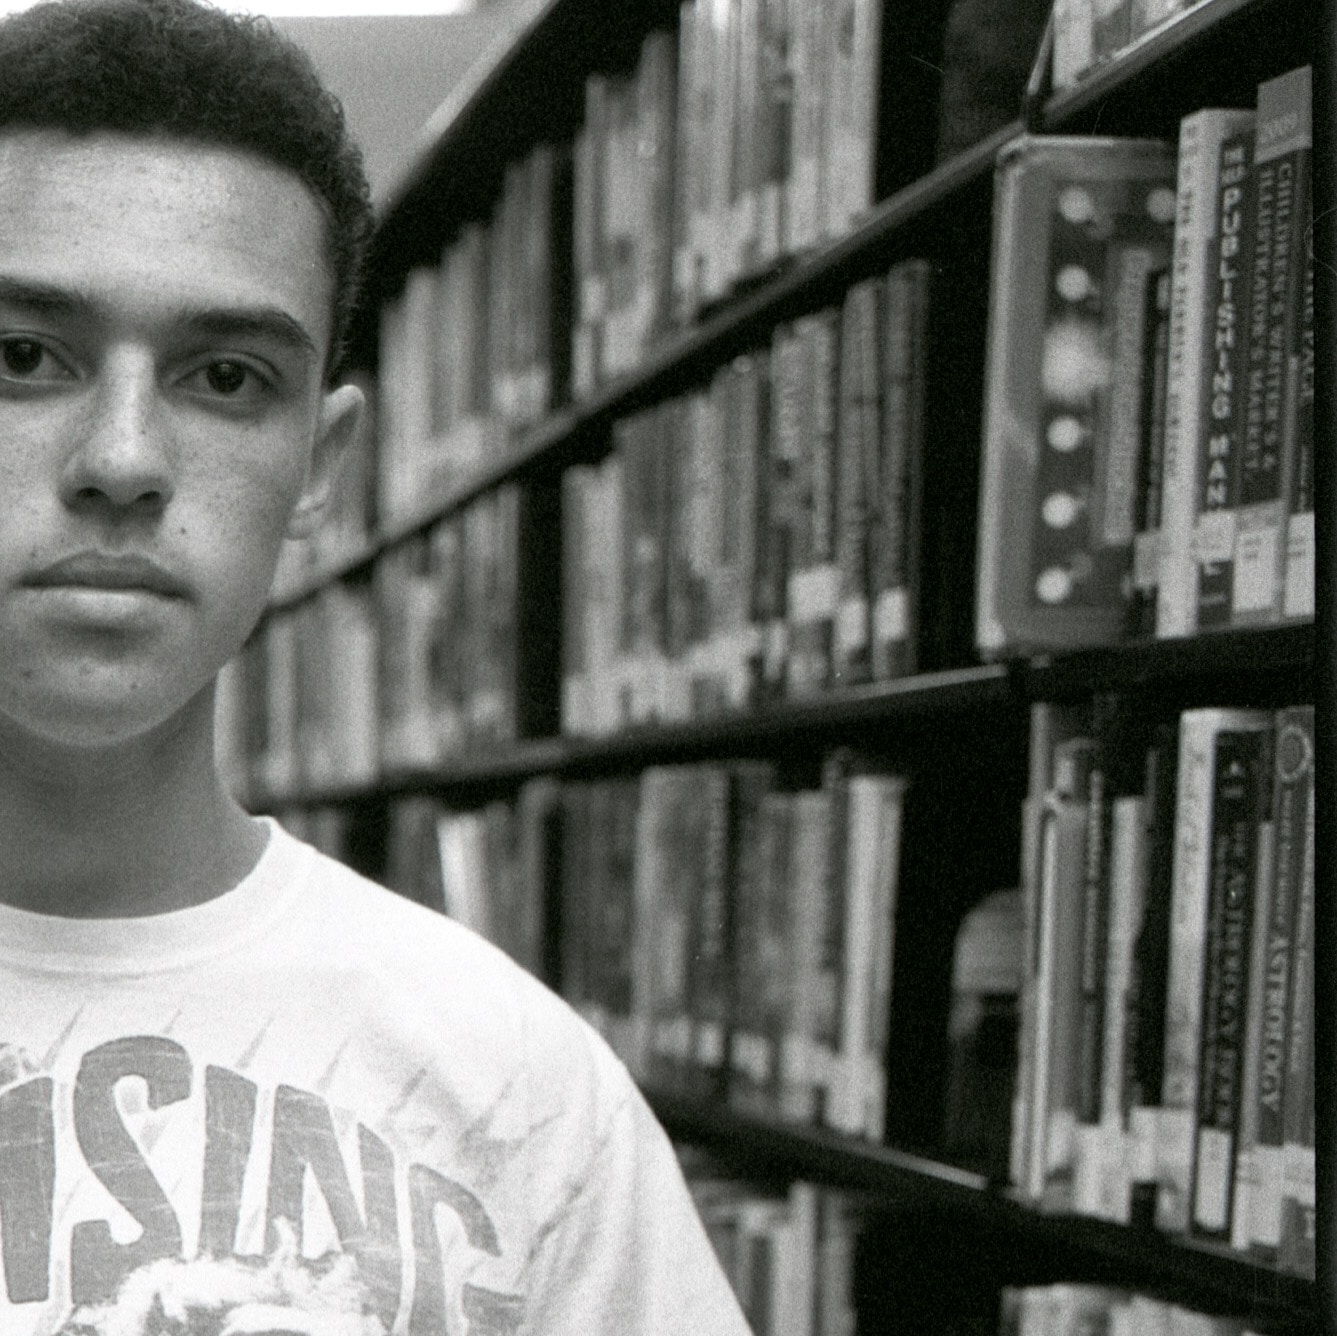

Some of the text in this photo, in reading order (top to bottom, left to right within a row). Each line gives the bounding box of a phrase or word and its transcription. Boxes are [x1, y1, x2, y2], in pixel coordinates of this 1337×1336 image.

[1211, 187, 1243, 419] PUBLISHING
[1242, 371, 1262, 471] MARKET
[1263, 327, 1282, 445] WRITER'S
[1259, 935, 1289, 1111] ASTROLOGY
